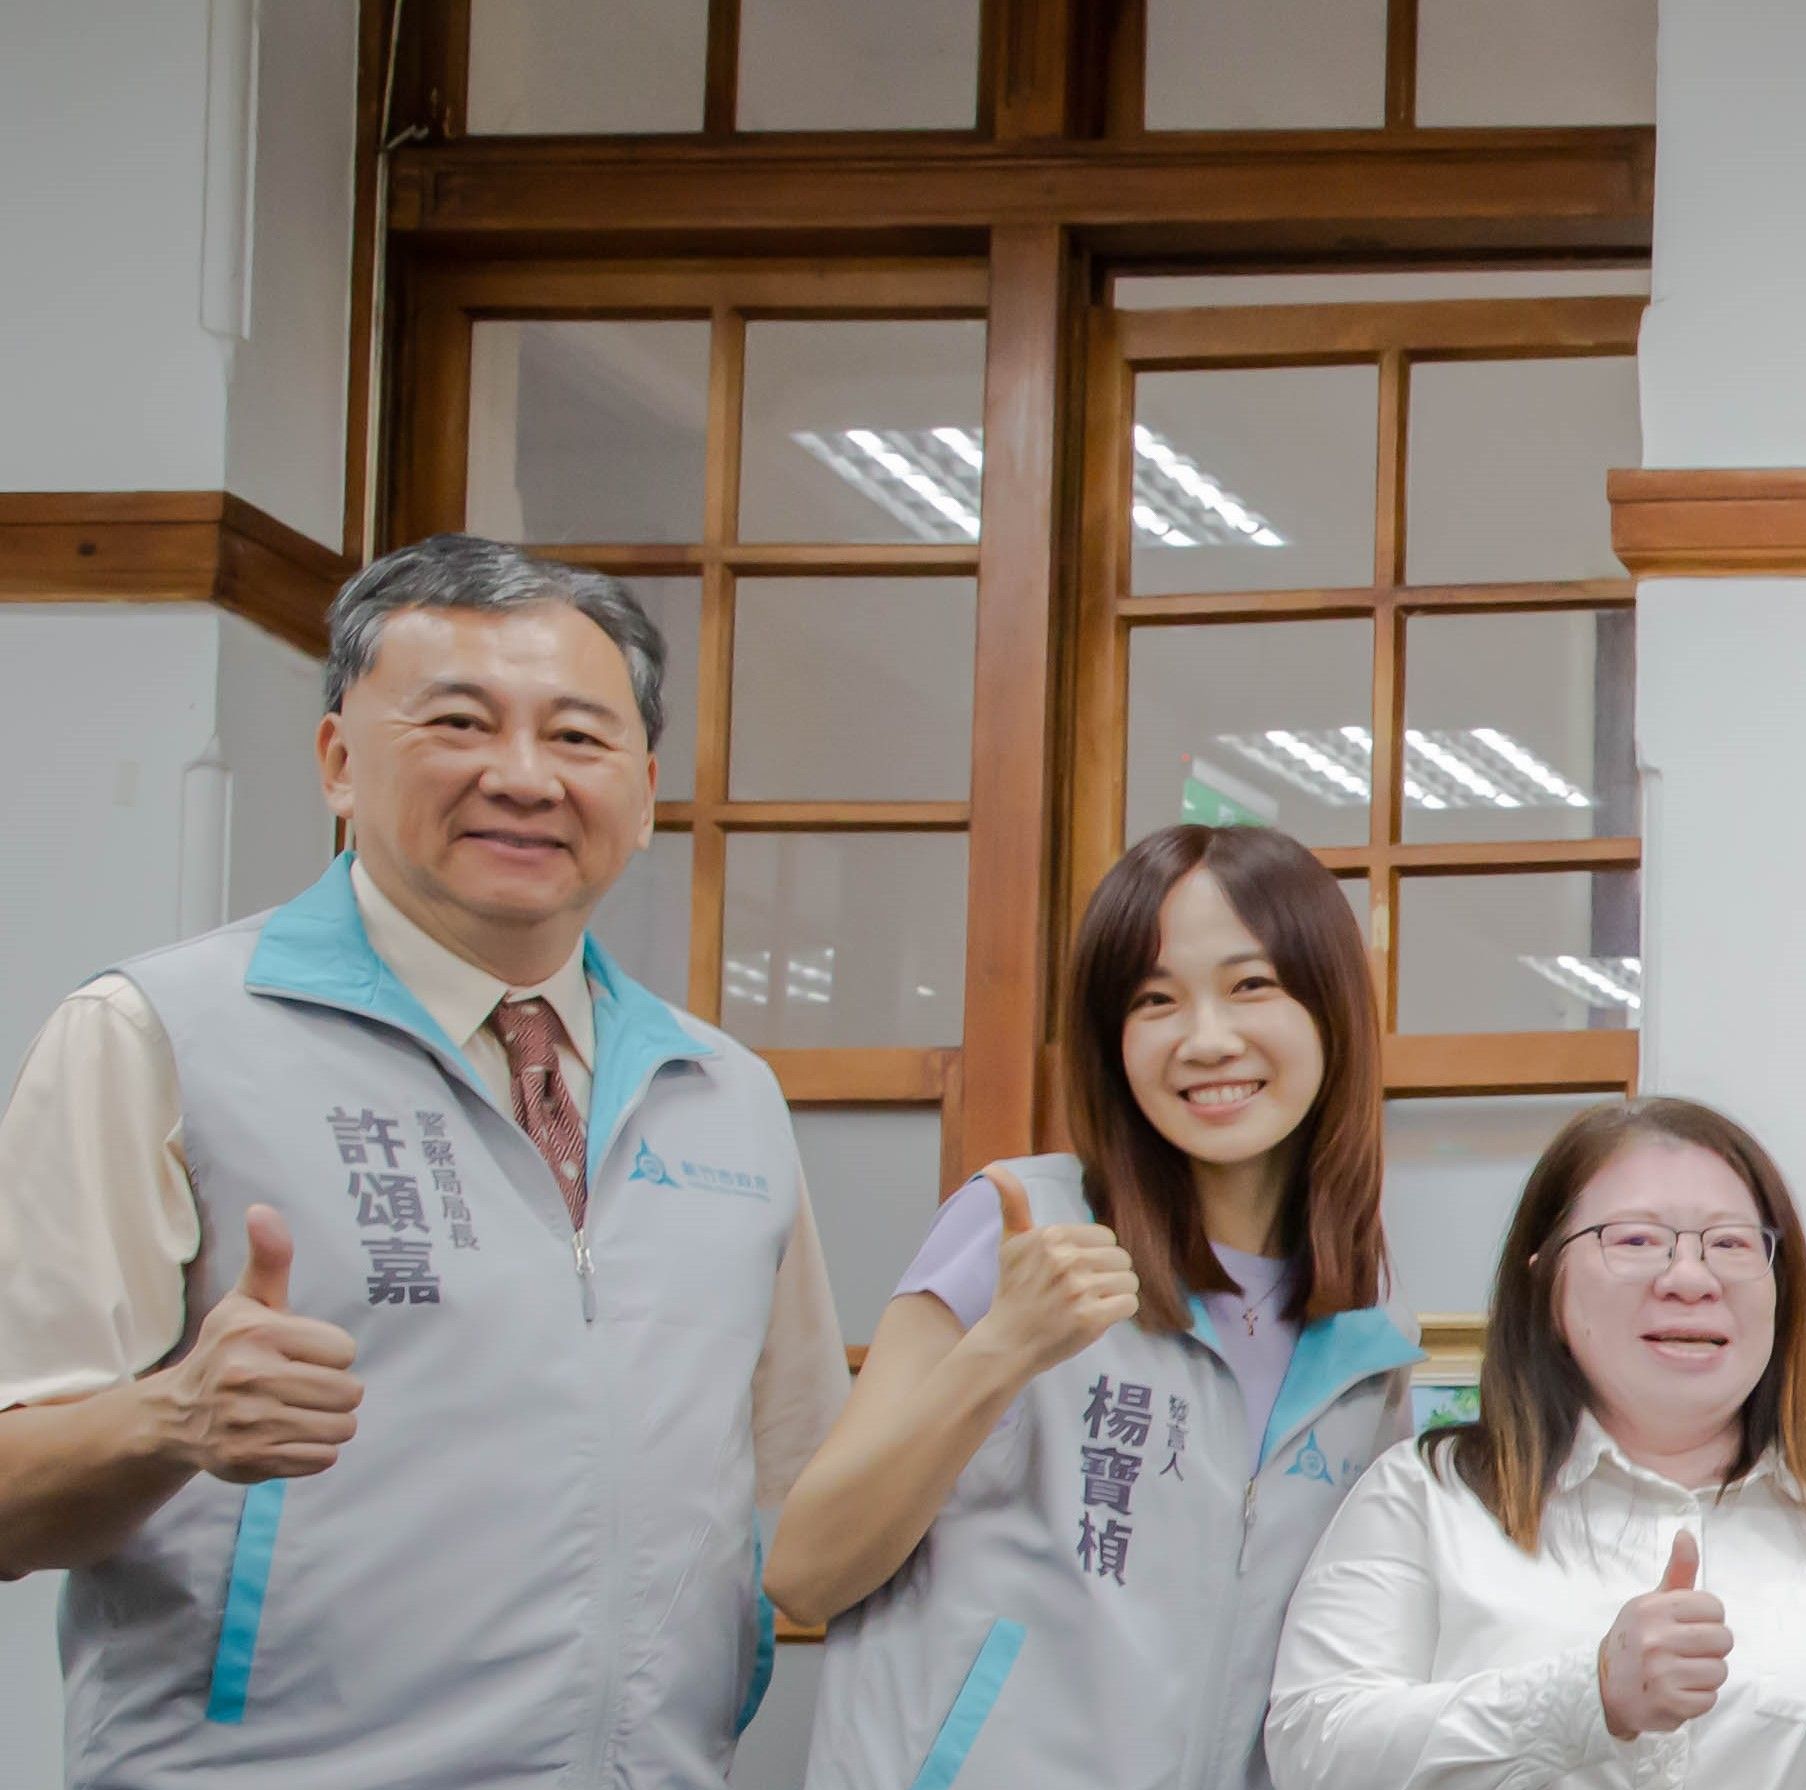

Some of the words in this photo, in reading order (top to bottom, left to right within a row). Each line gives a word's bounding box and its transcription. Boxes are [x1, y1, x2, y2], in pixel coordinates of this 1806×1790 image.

[326, 1106, 441, 1305] 許頌嘉
[415, 1110, 481, 1251] 警察局局長
